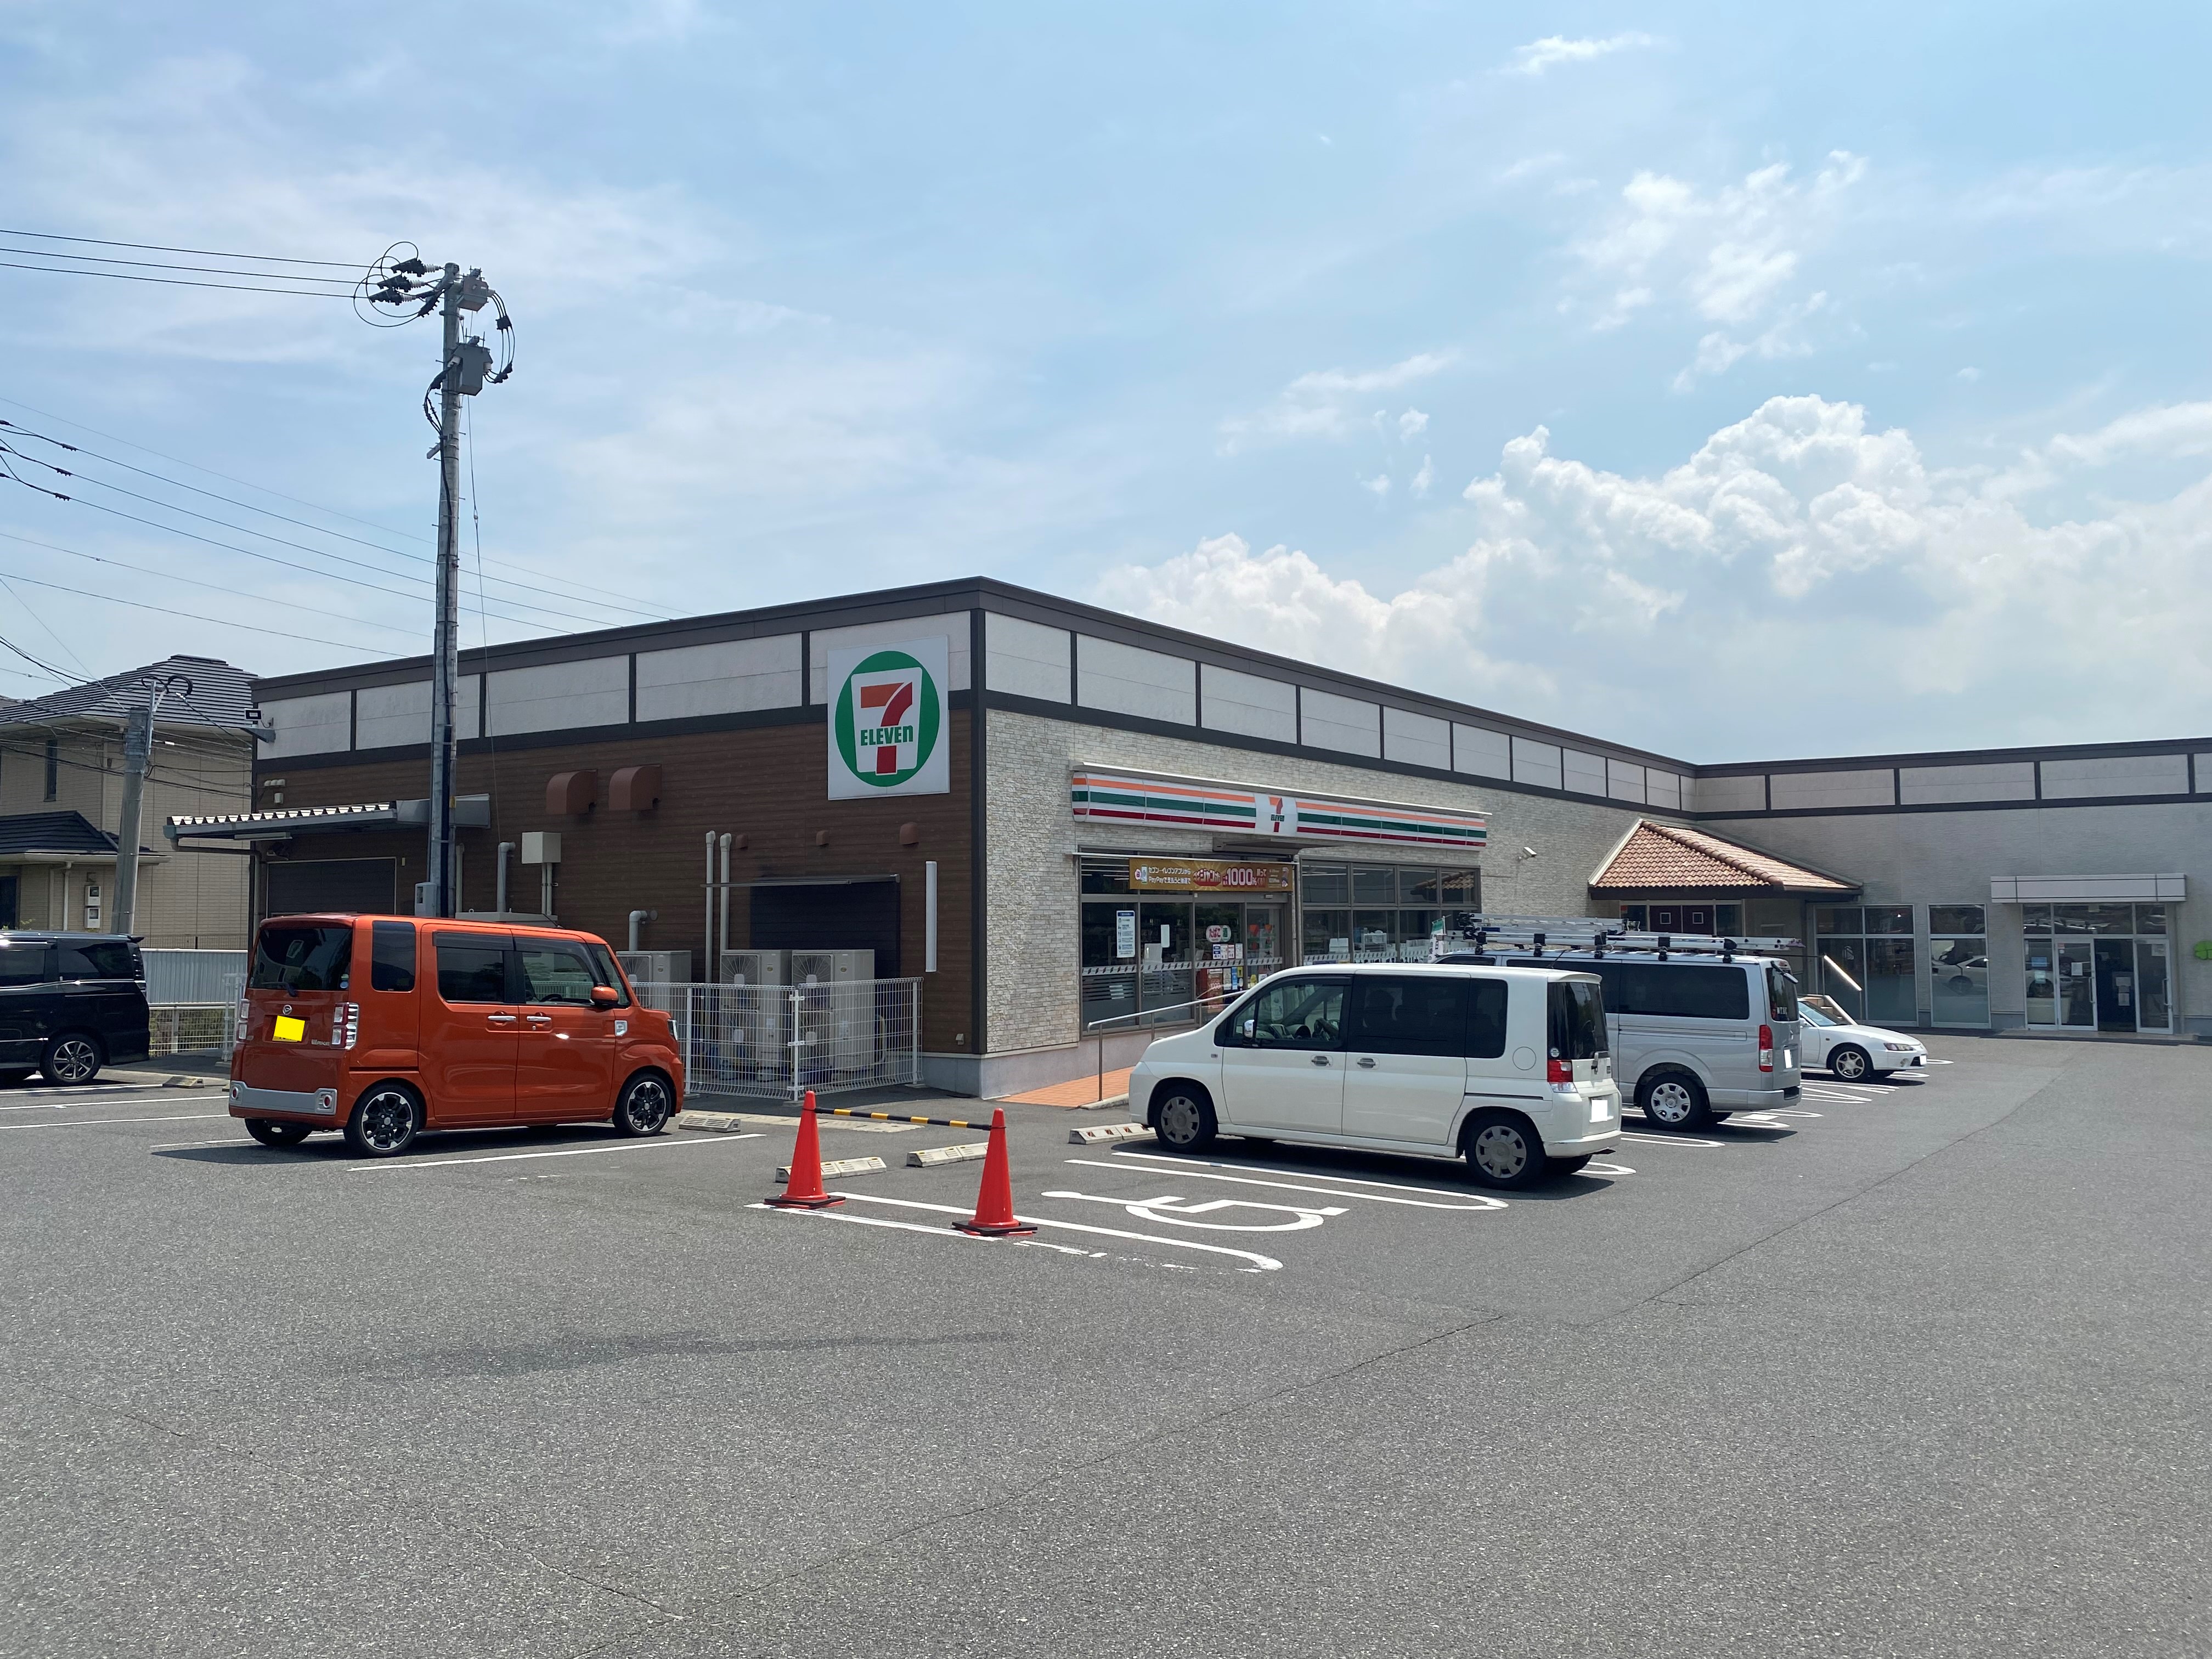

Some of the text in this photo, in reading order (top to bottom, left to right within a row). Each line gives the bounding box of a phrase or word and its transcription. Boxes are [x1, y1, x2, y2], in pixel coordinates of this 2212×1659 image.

[860, 681, 913, 774] 7
[1209, 928, 1221, 938] たばこ
